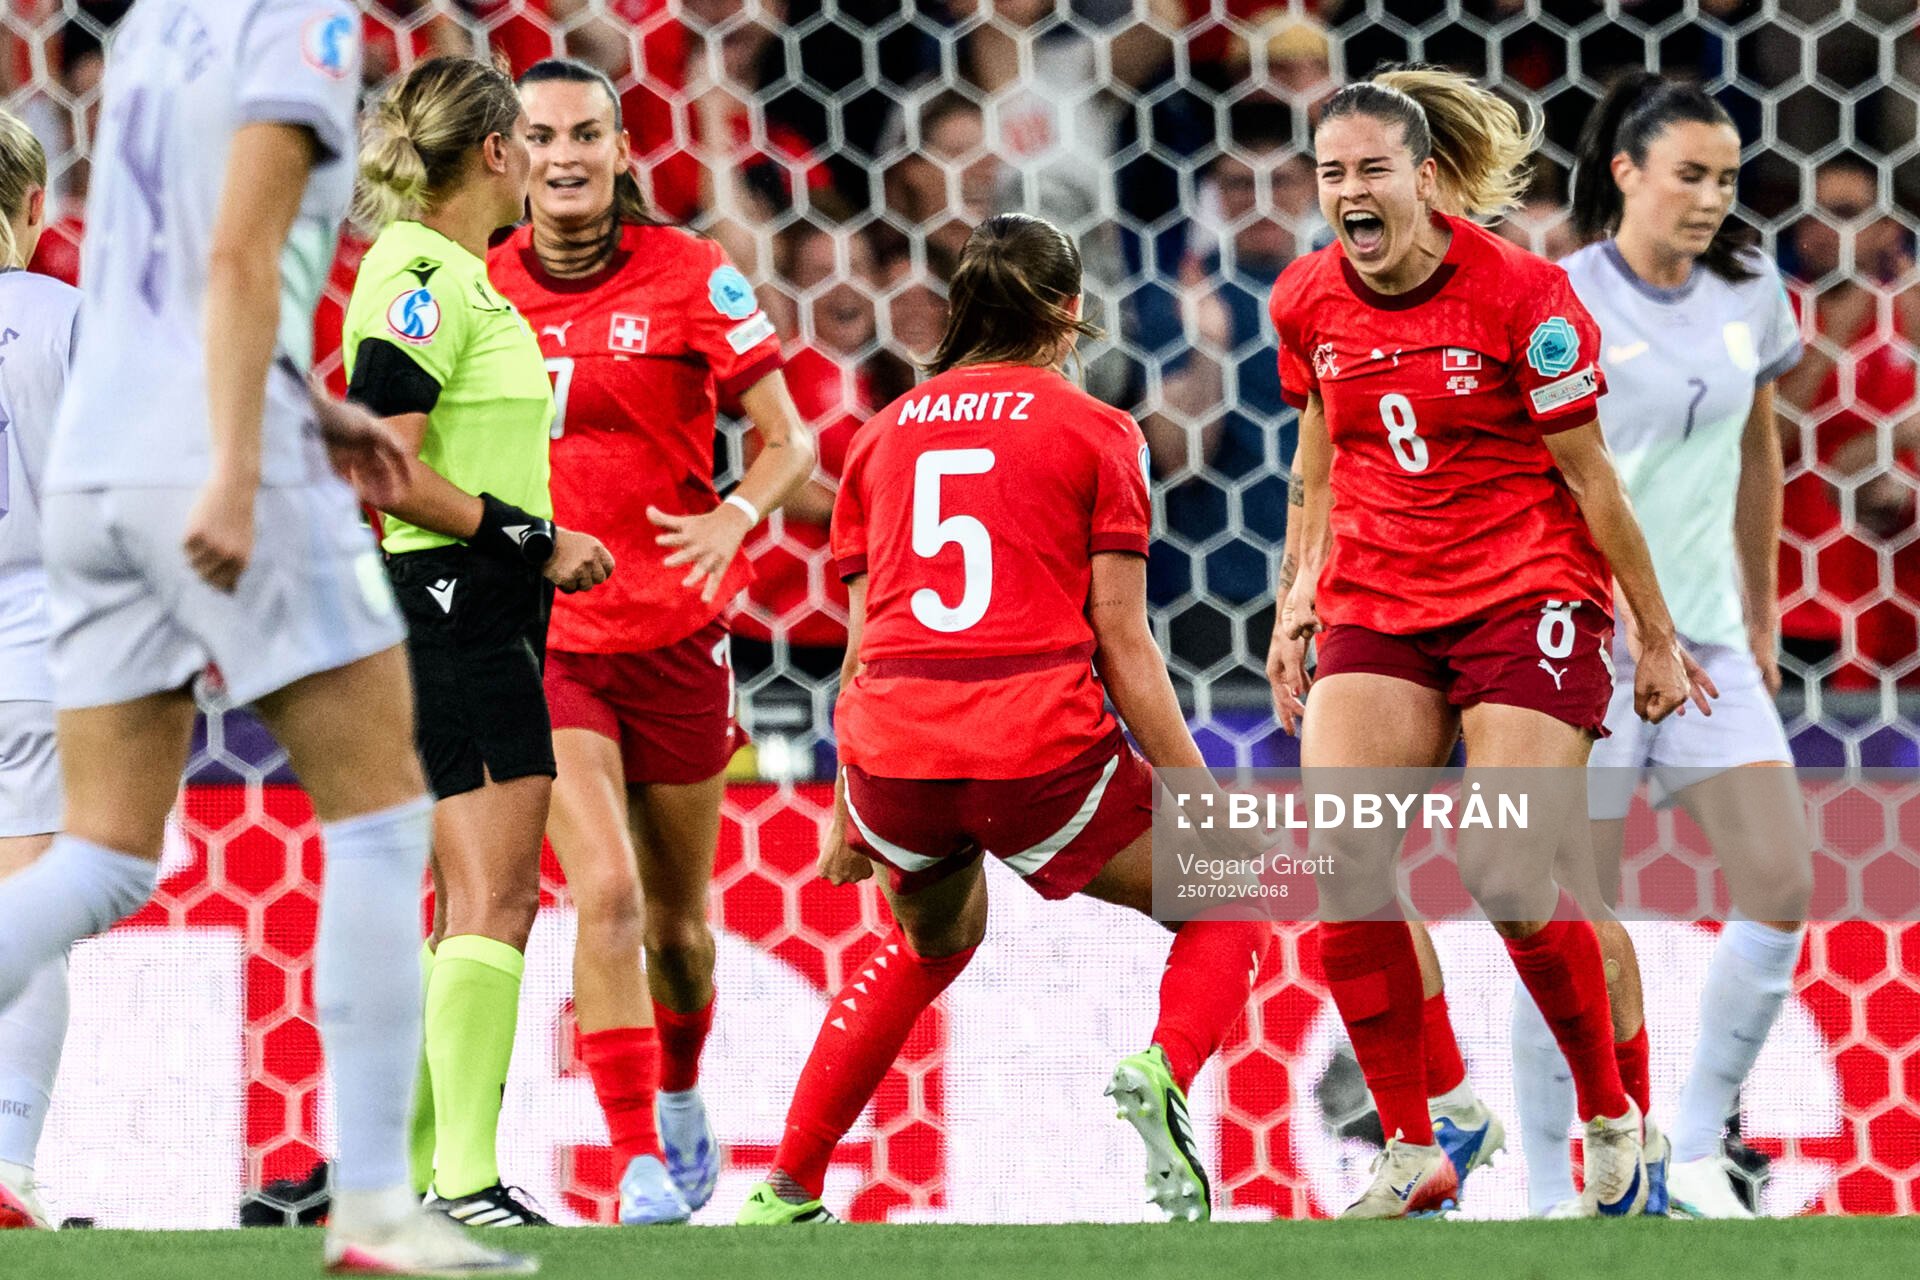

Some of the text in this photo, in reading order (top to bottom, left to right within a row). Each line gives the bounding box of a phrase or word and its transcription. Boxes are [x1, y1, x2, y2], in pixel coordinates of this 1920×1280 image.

[897, 391, 1035, 425] MARITZ
[1379, 393, 1429, 472] 8
[1685, 377, 1708, 442] 7
[910, 448, 996, 632] 5
[0, 1099, 32, 1119] RGE
